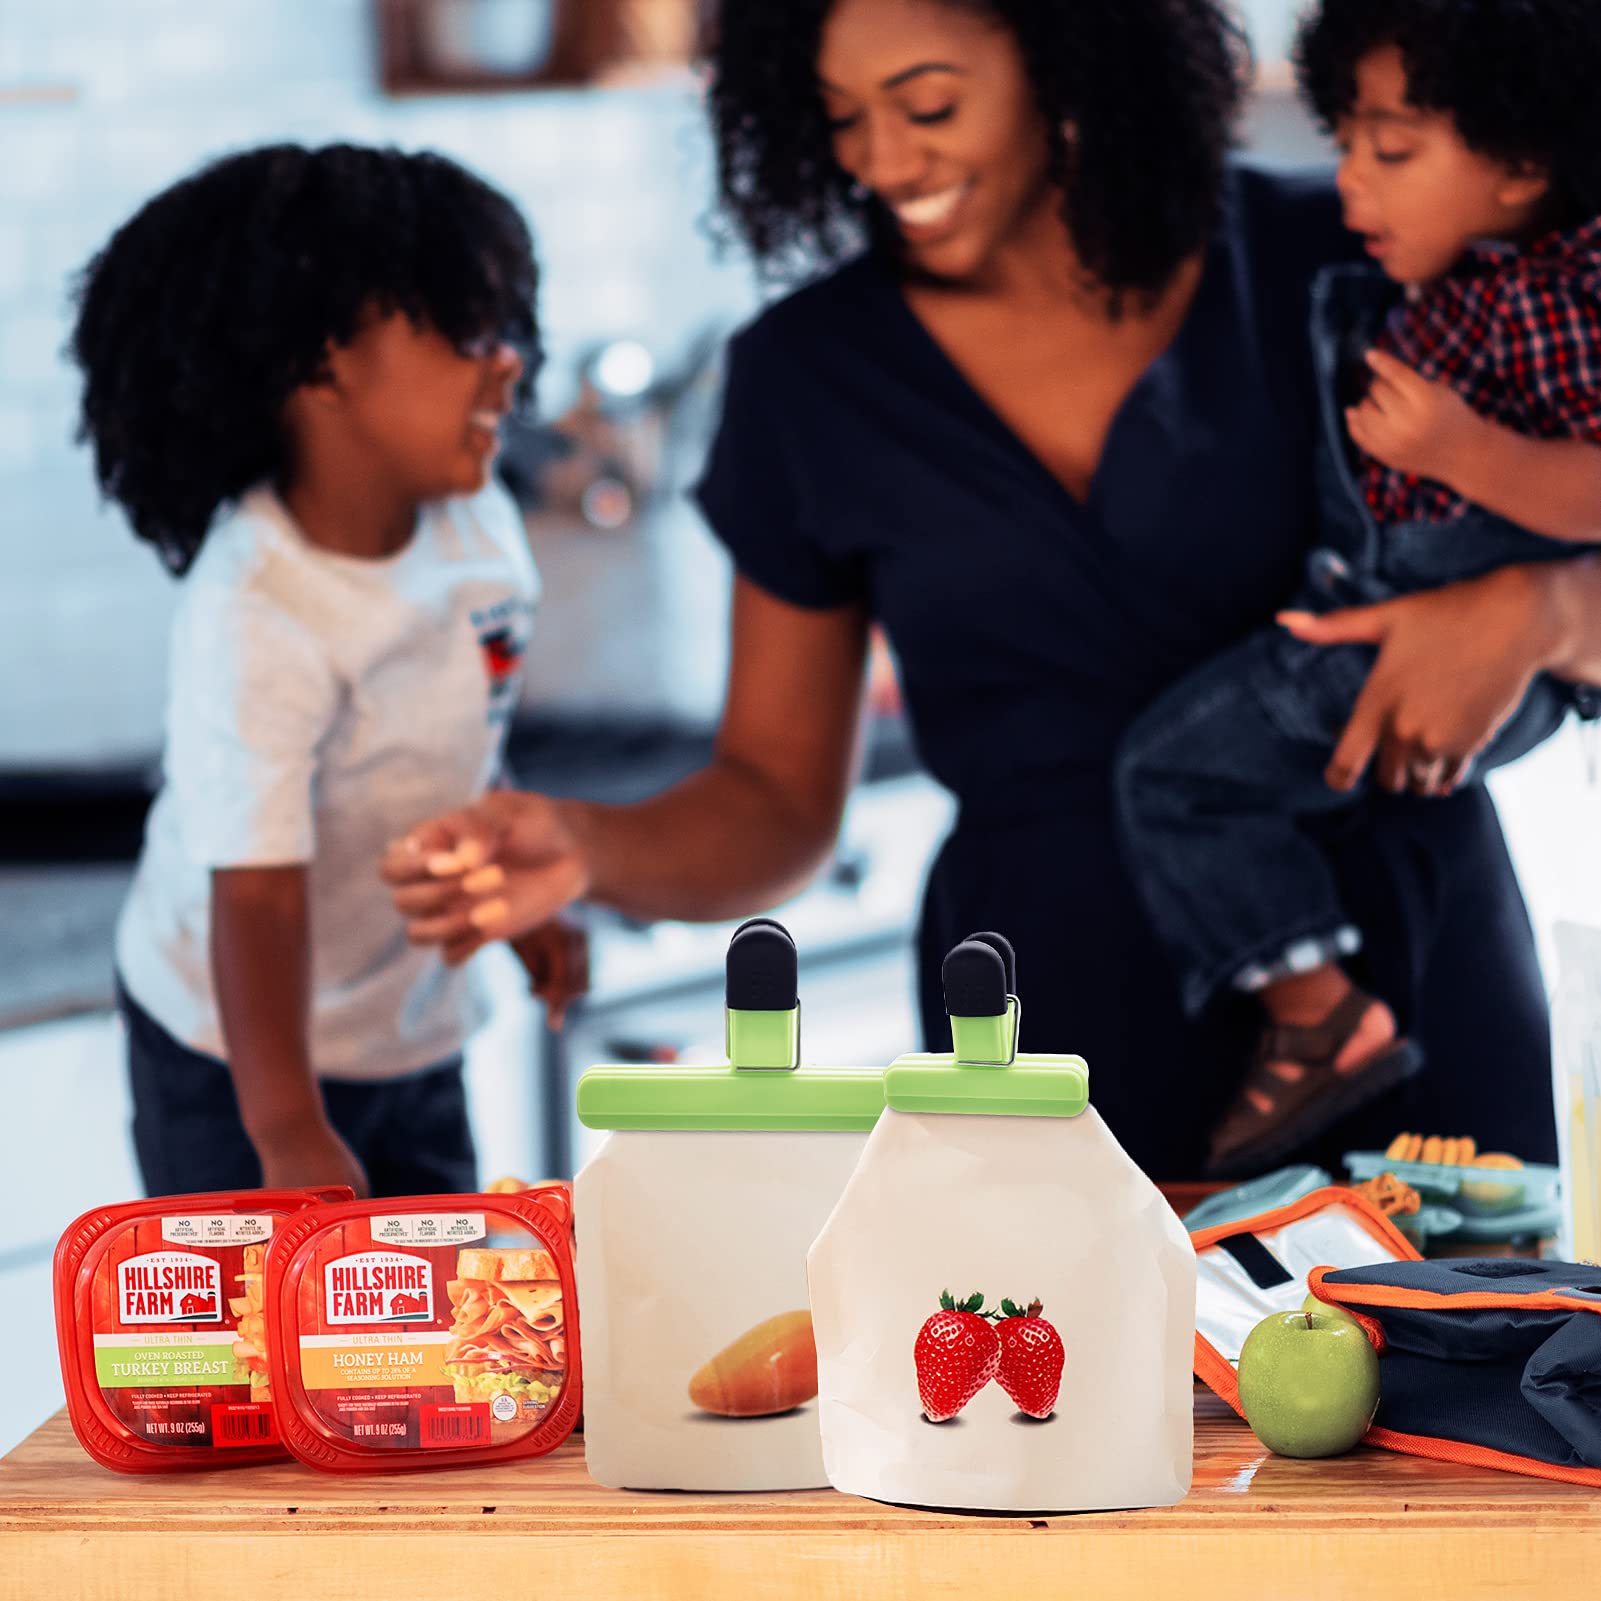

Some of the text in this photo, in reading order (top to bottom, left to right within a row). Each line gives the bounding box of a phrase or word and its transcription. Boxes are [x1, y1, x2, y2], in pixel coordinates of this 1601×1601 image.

[125, 1266, 215, 1290] HILLSHIRE
[332, 1265, 427, 1291] HILLSHIRE
[126, 1292, 173, 1315] FARM
[333, 1292, 383, 1316] FARM
[144, 1336, 170, 1344] ULTRA
[352, 1335, 403, 1344] ULTRA THIN
[135, 1351, 204, 1360] OVEN ROASTED
[333, 1351, 423, 1367] HONEY HAM
[112, 1361, 228, 1376] TURKEY BREAST
[146, 1423, 157, 1434] NET
[171, 1423, 175, 1433] 9
[176, 1423, 184, 1433] OZ
[354, 1425, 365, 1436] NET
[376, 1424, 380, 1434] 9
[381, 1424, 388, 1434] OZ
